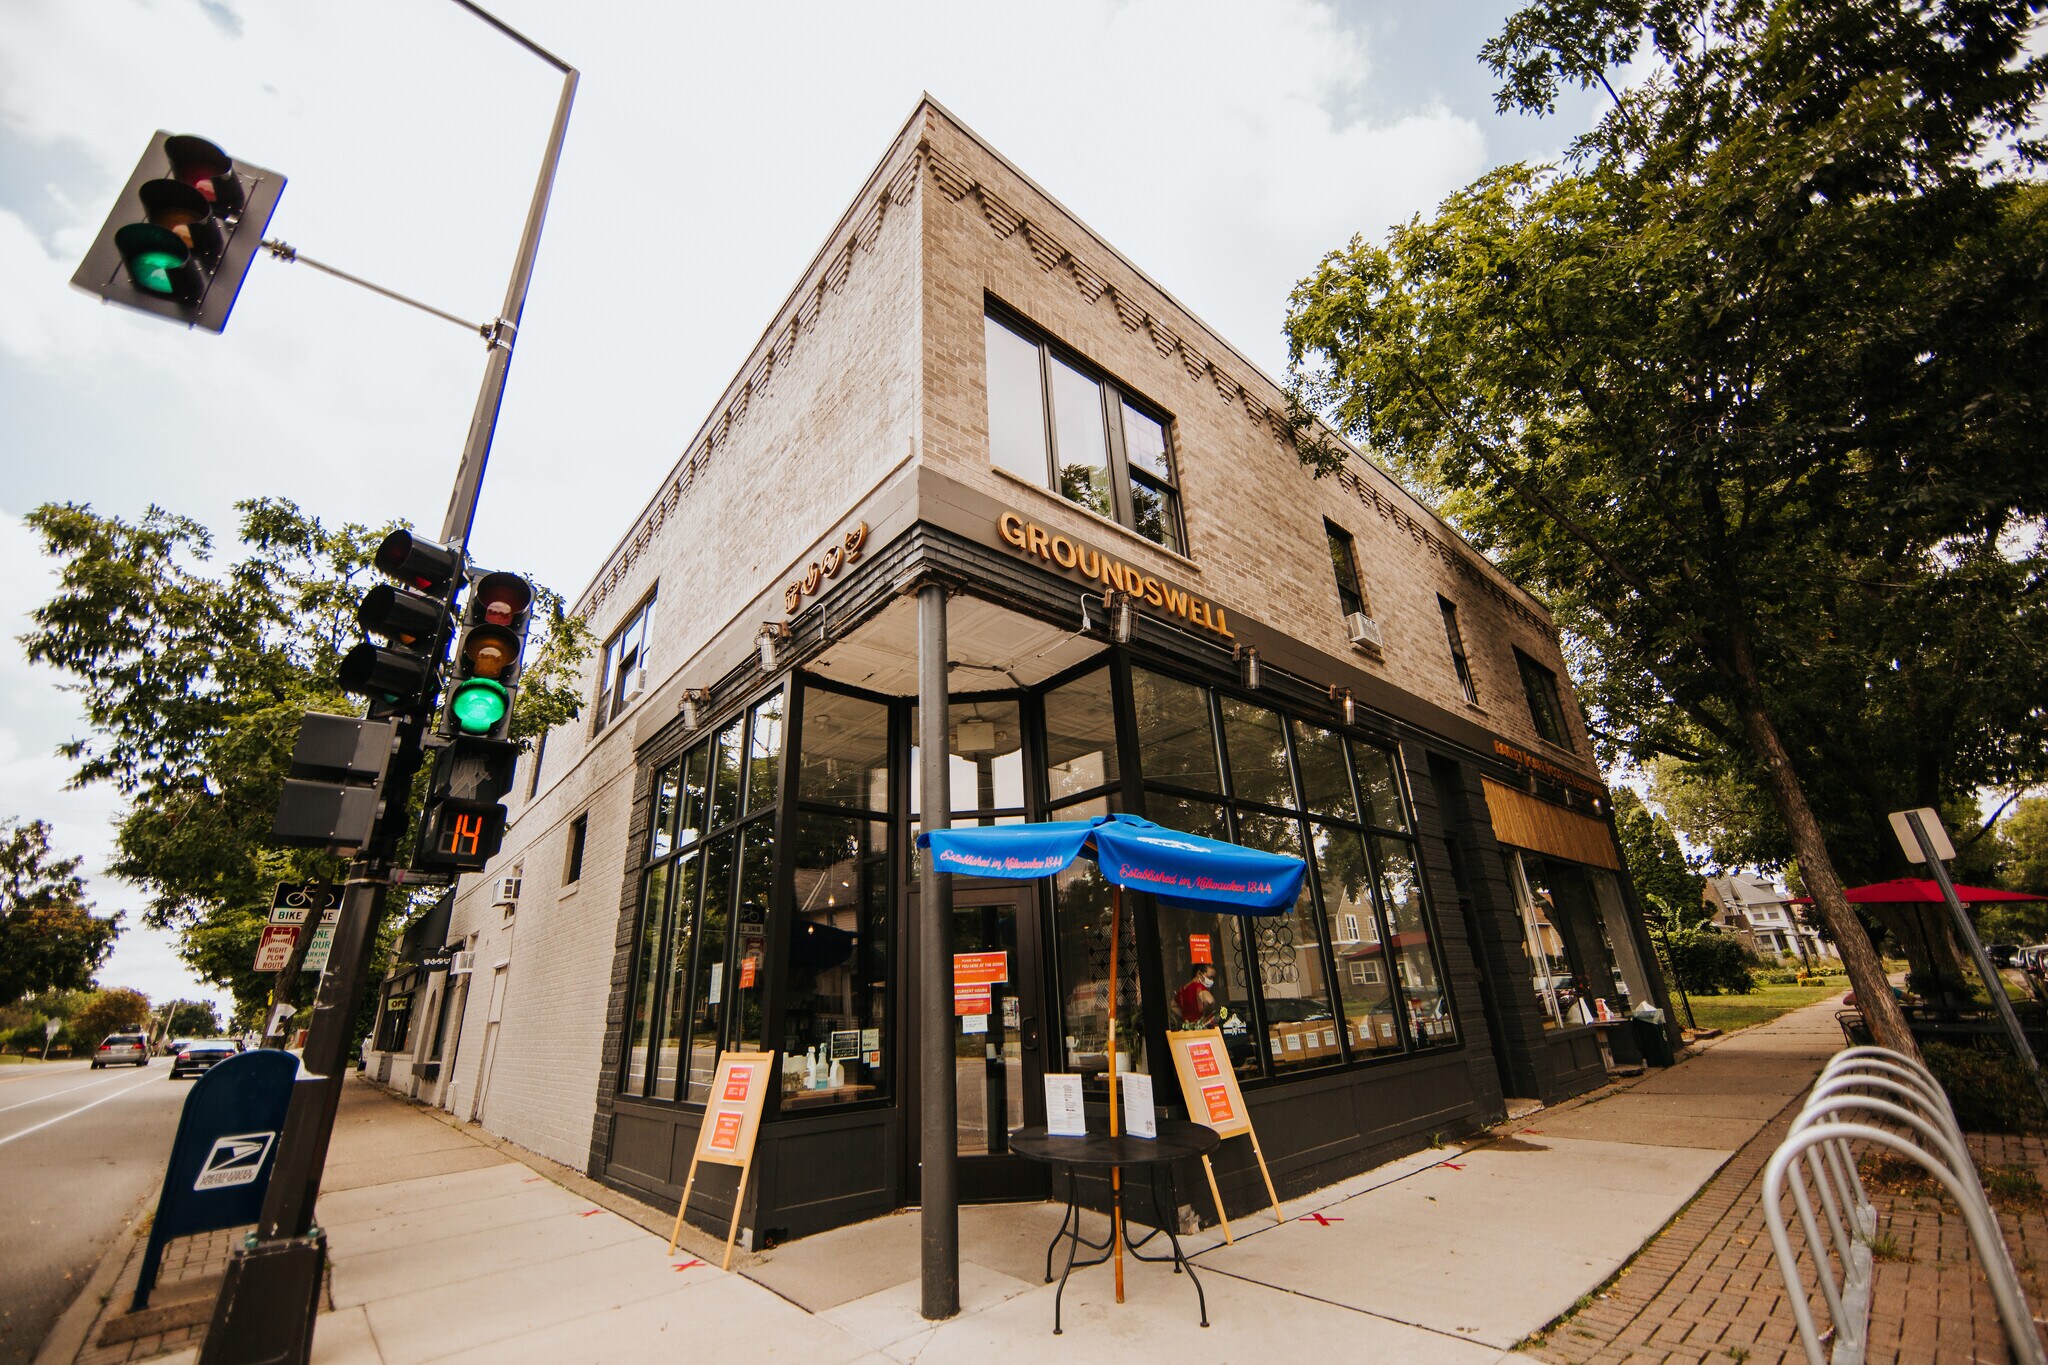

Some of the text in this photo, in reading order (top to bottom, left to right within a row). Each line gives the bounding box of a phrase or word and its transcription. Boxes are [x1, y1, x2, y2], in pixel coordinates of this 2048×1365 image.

[997, 511, 1235, 639] GROUNDSWELL
[450, 814, 482, 855] 14
[940, 849, 1063, 870] Established in Milwaukee 1844
[1119, 864, 1273, 894] Established in Milwaukee 1844
[278, 911, 303, 920] BIKE
[267, 946, 288, 954] NIGHT
[311, 941, 331, 949] OUR
[262, 961, 285, 969] ROUTE
[391, 999, 408, 1009] OPE
